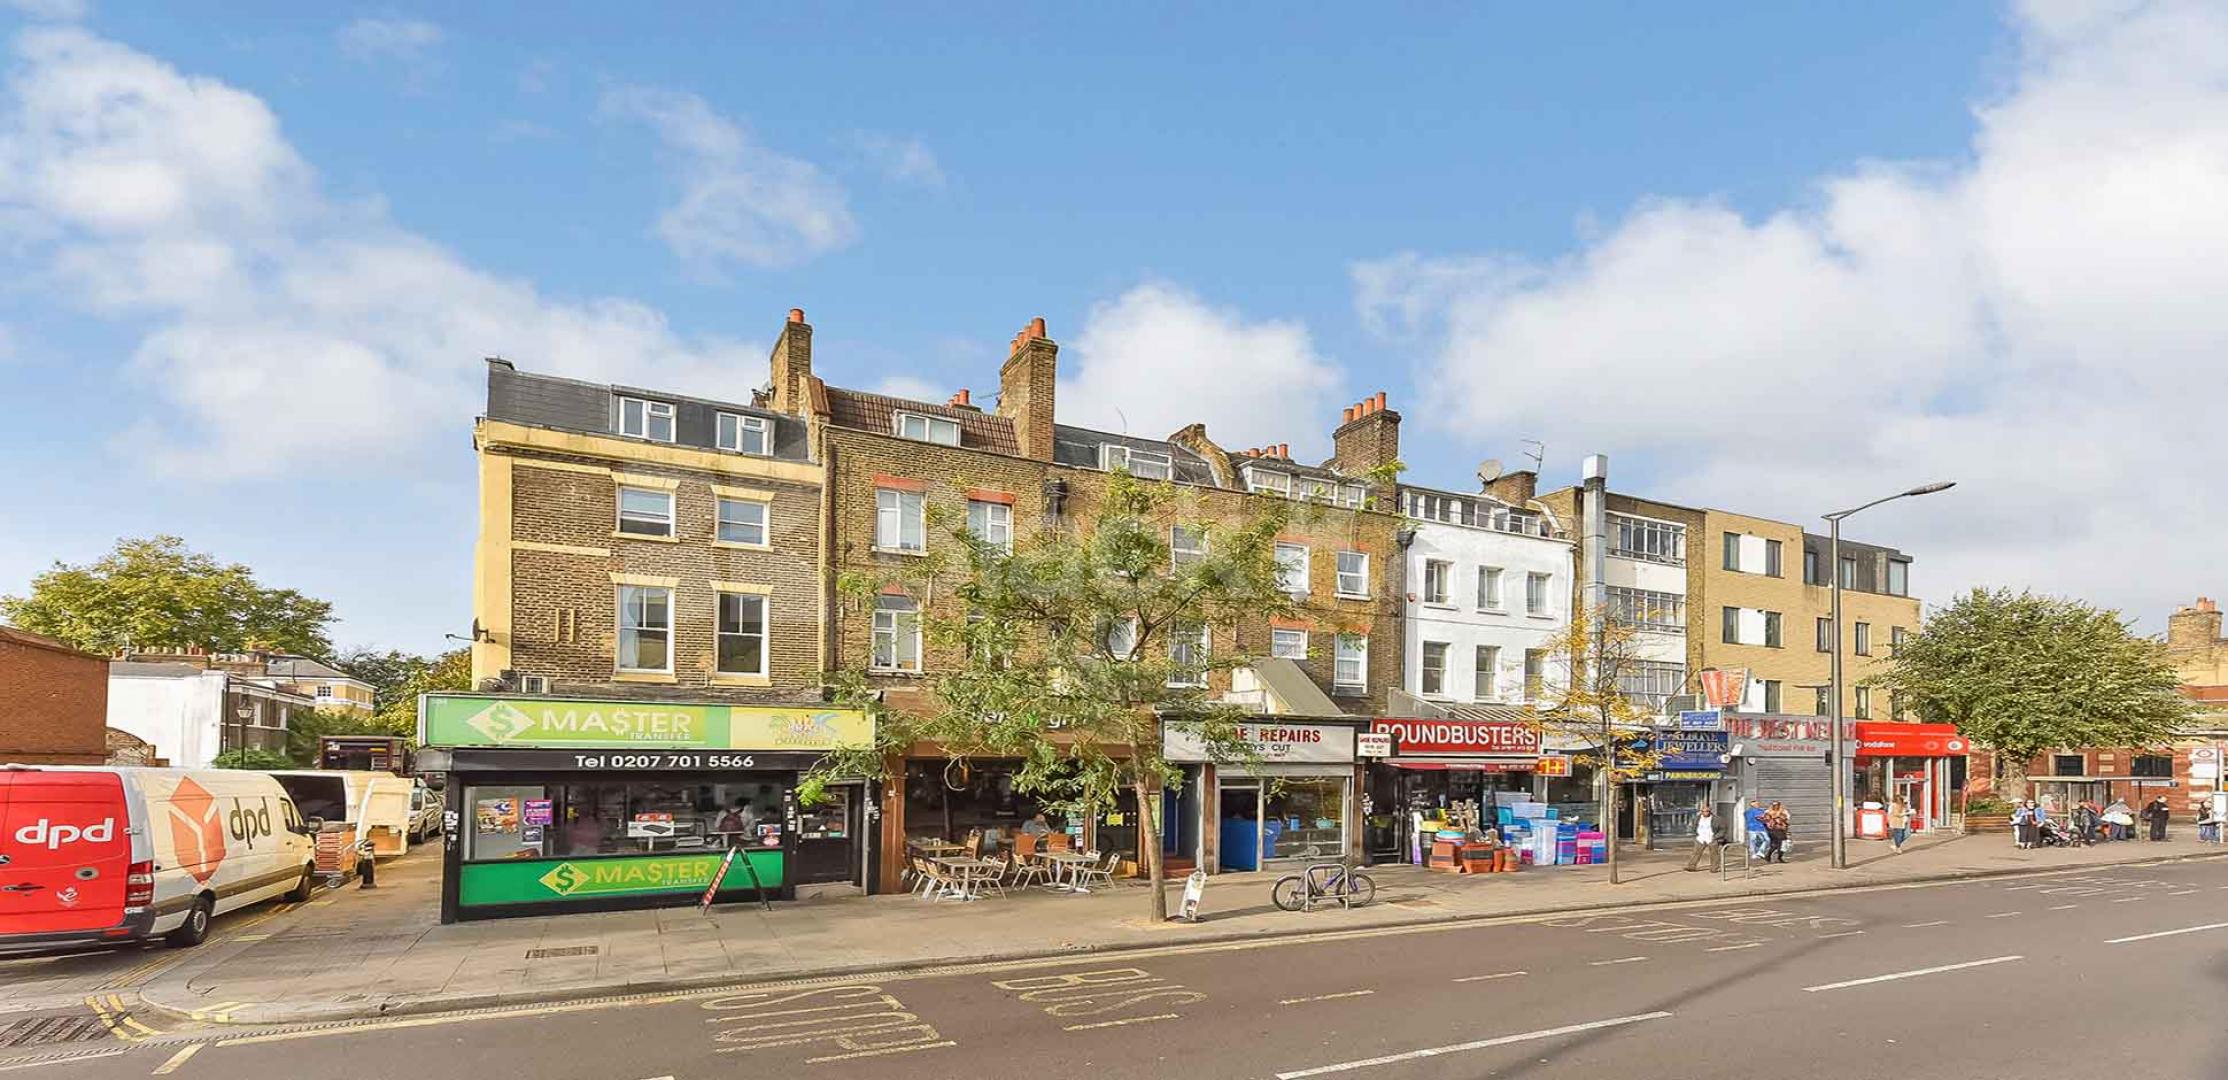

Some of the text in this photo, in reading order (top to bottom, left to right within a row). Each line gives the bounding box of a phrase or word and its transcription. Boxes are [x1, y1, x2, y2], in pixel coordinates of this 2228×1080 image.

[1260, 728, 1321, 743] REPAIRS
[575, 755, 754, 768] Tel 0207 701 5566
[15, 818, 116, 850] dpd
[230, 797, 272, 850] dpd
